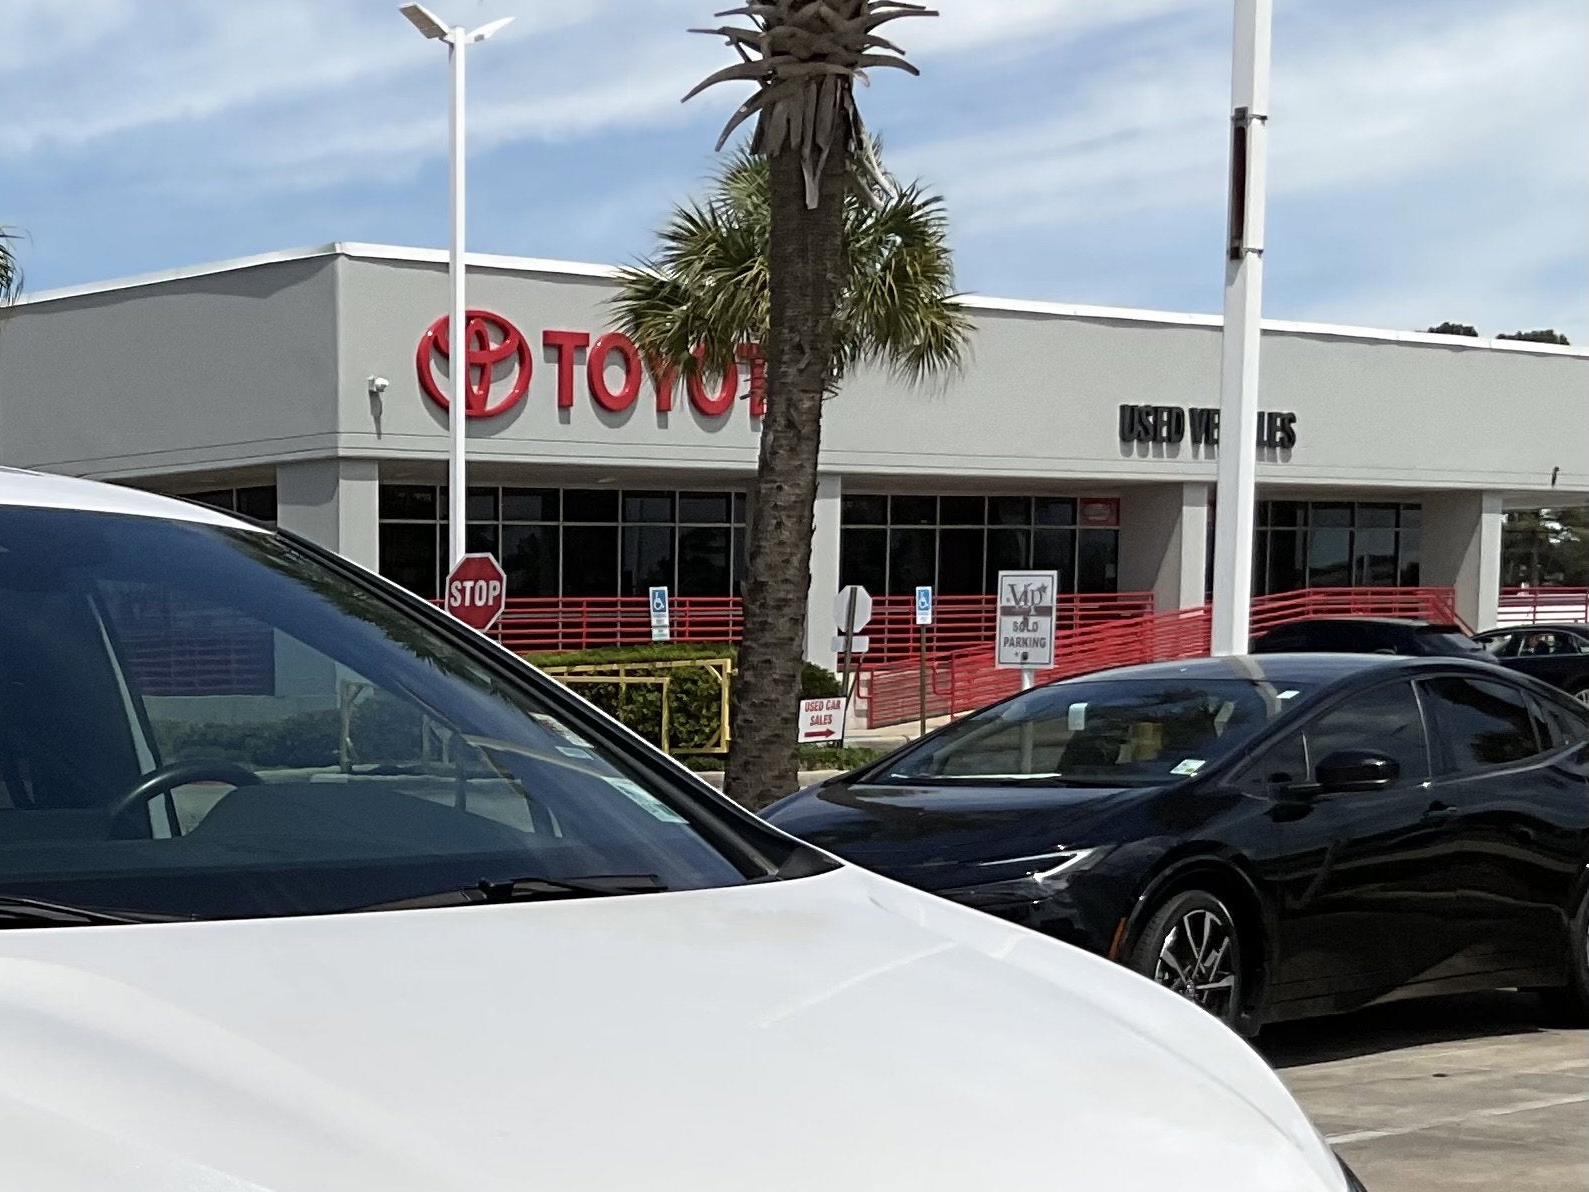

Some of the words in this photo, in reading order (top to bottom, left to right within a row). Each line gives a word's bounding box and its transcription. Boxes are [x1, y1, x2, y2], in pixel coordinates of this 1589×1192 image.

[542, 329, 767, 417] TOYOT
[1119, 404, 1185, 443] USED
[1188, 407, 1297, 450] VELES
[450, 580, 501, 607] STOP
[1012, 621, 1038, 632] SOLD
[1003, 636, 1046, 648] PARKING
[805, 700, 824, 712] USED
[826, 700, 841, 710] CAR
[810, 714, 833, 726] SALES
